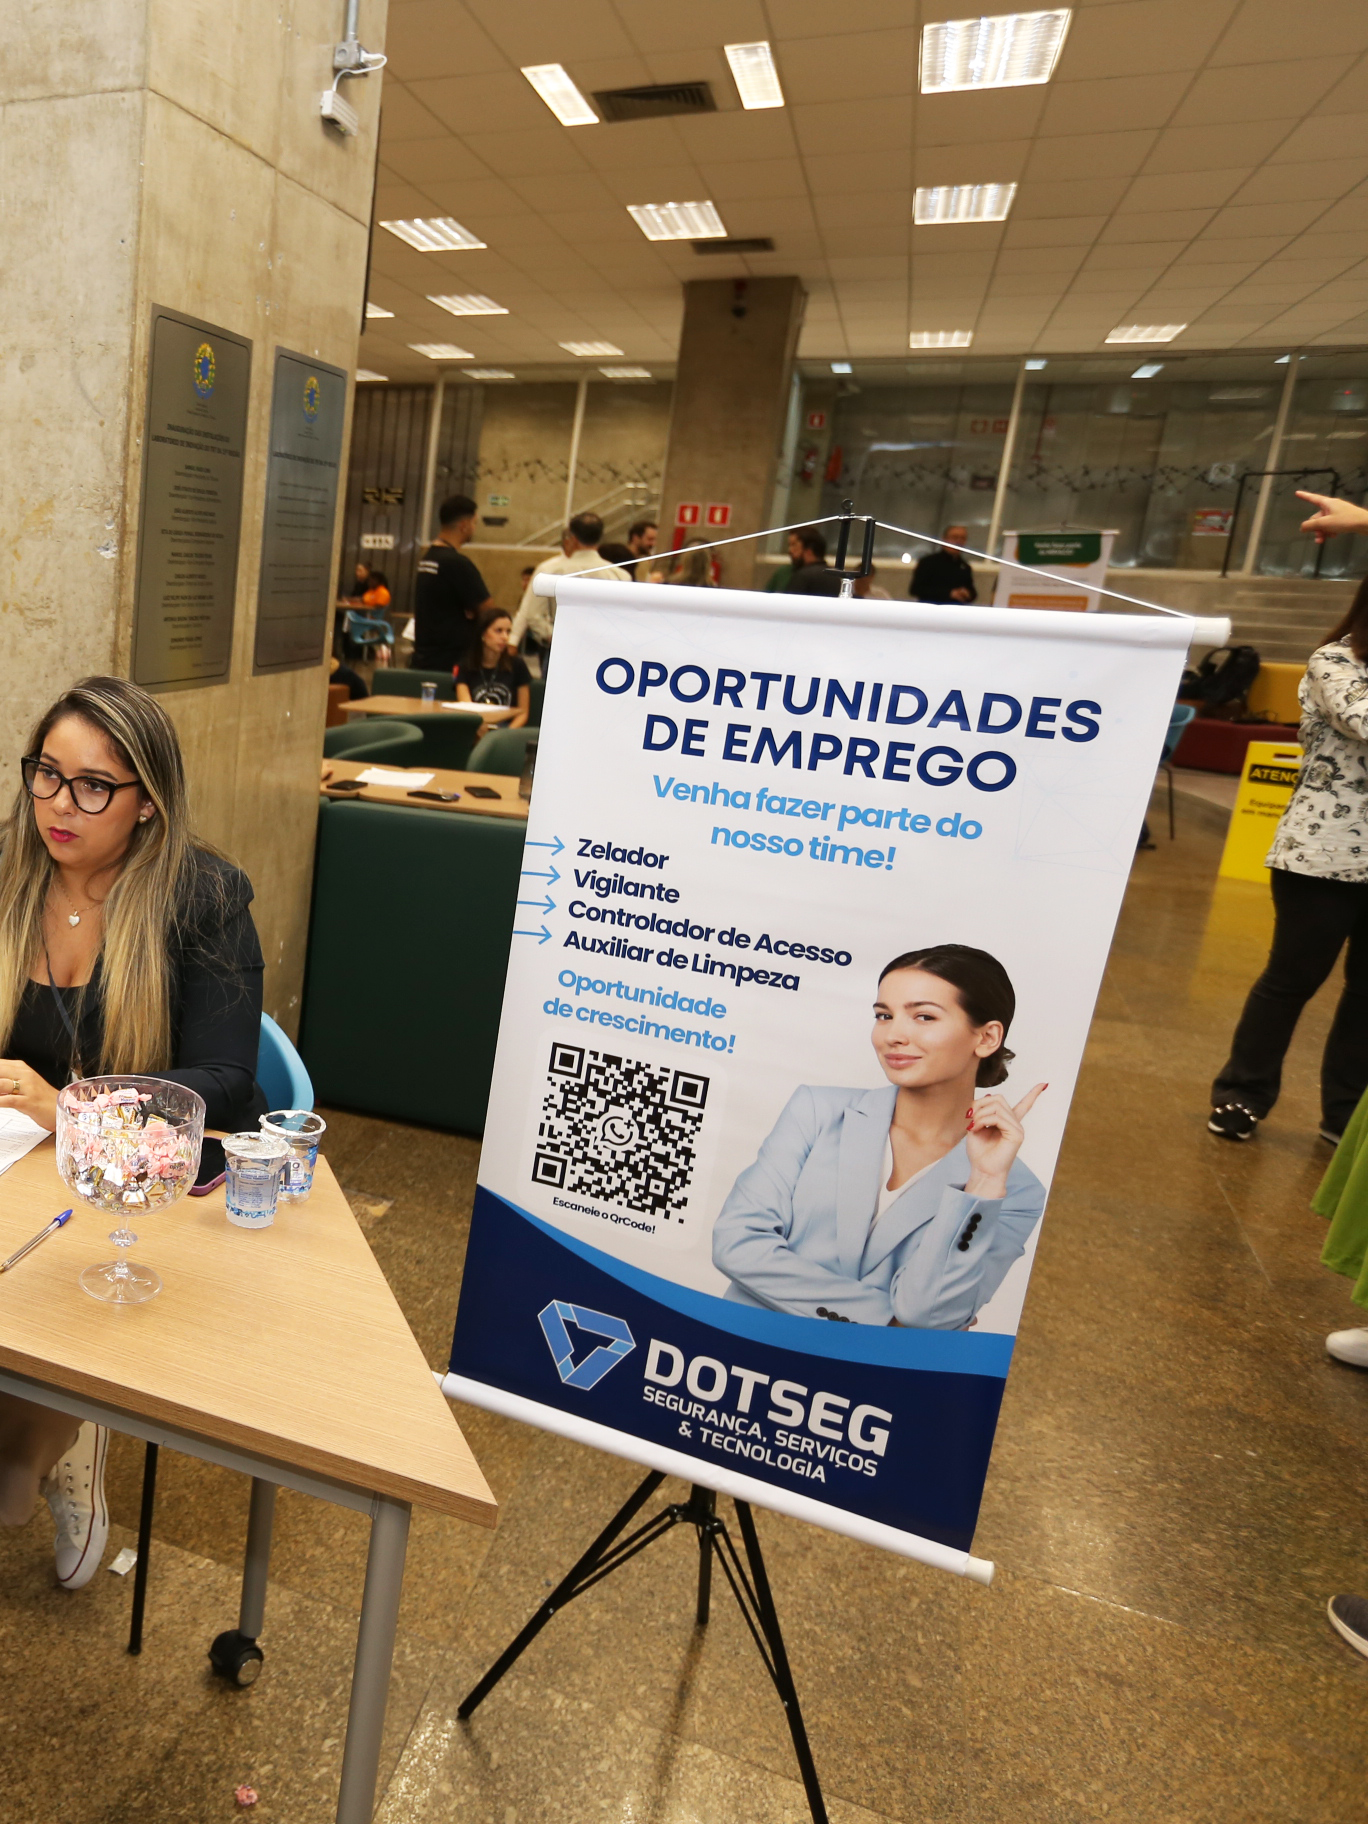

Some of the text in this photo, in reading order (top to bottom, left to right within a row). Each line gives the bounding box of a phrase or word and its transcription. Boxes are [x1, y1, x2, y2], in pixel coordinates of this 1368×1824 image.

[596, 657, 1102, 743] OPORTUNIDADES
[642, 714, 1017, 792] DE EMPREGO
[653, 775, 983, 840] Venha fazer parte do
[577, 838, 669, 869] Zelador
[711, 826, 896, 871] nosso time!
[574, 869, 680, 903] Vigilante
[563, 931, 800, 991] Auxiliar de Limpeza
[568, 900, 852, 966] Controlador de Acesso
[558, 969, 727, 1019] Oportunidade
[543, 998, 736, 1054] de crescimento!
[552, 1196, 656, 1234] Escaneie o QrCode!
[644, 1338, 893, 1457] DOTSEG
[642, 1385, 878, 1477] SEGURANÇA, SERVIÇOS
[678, 1421, 826, 1483] & TECNOLOGIA
